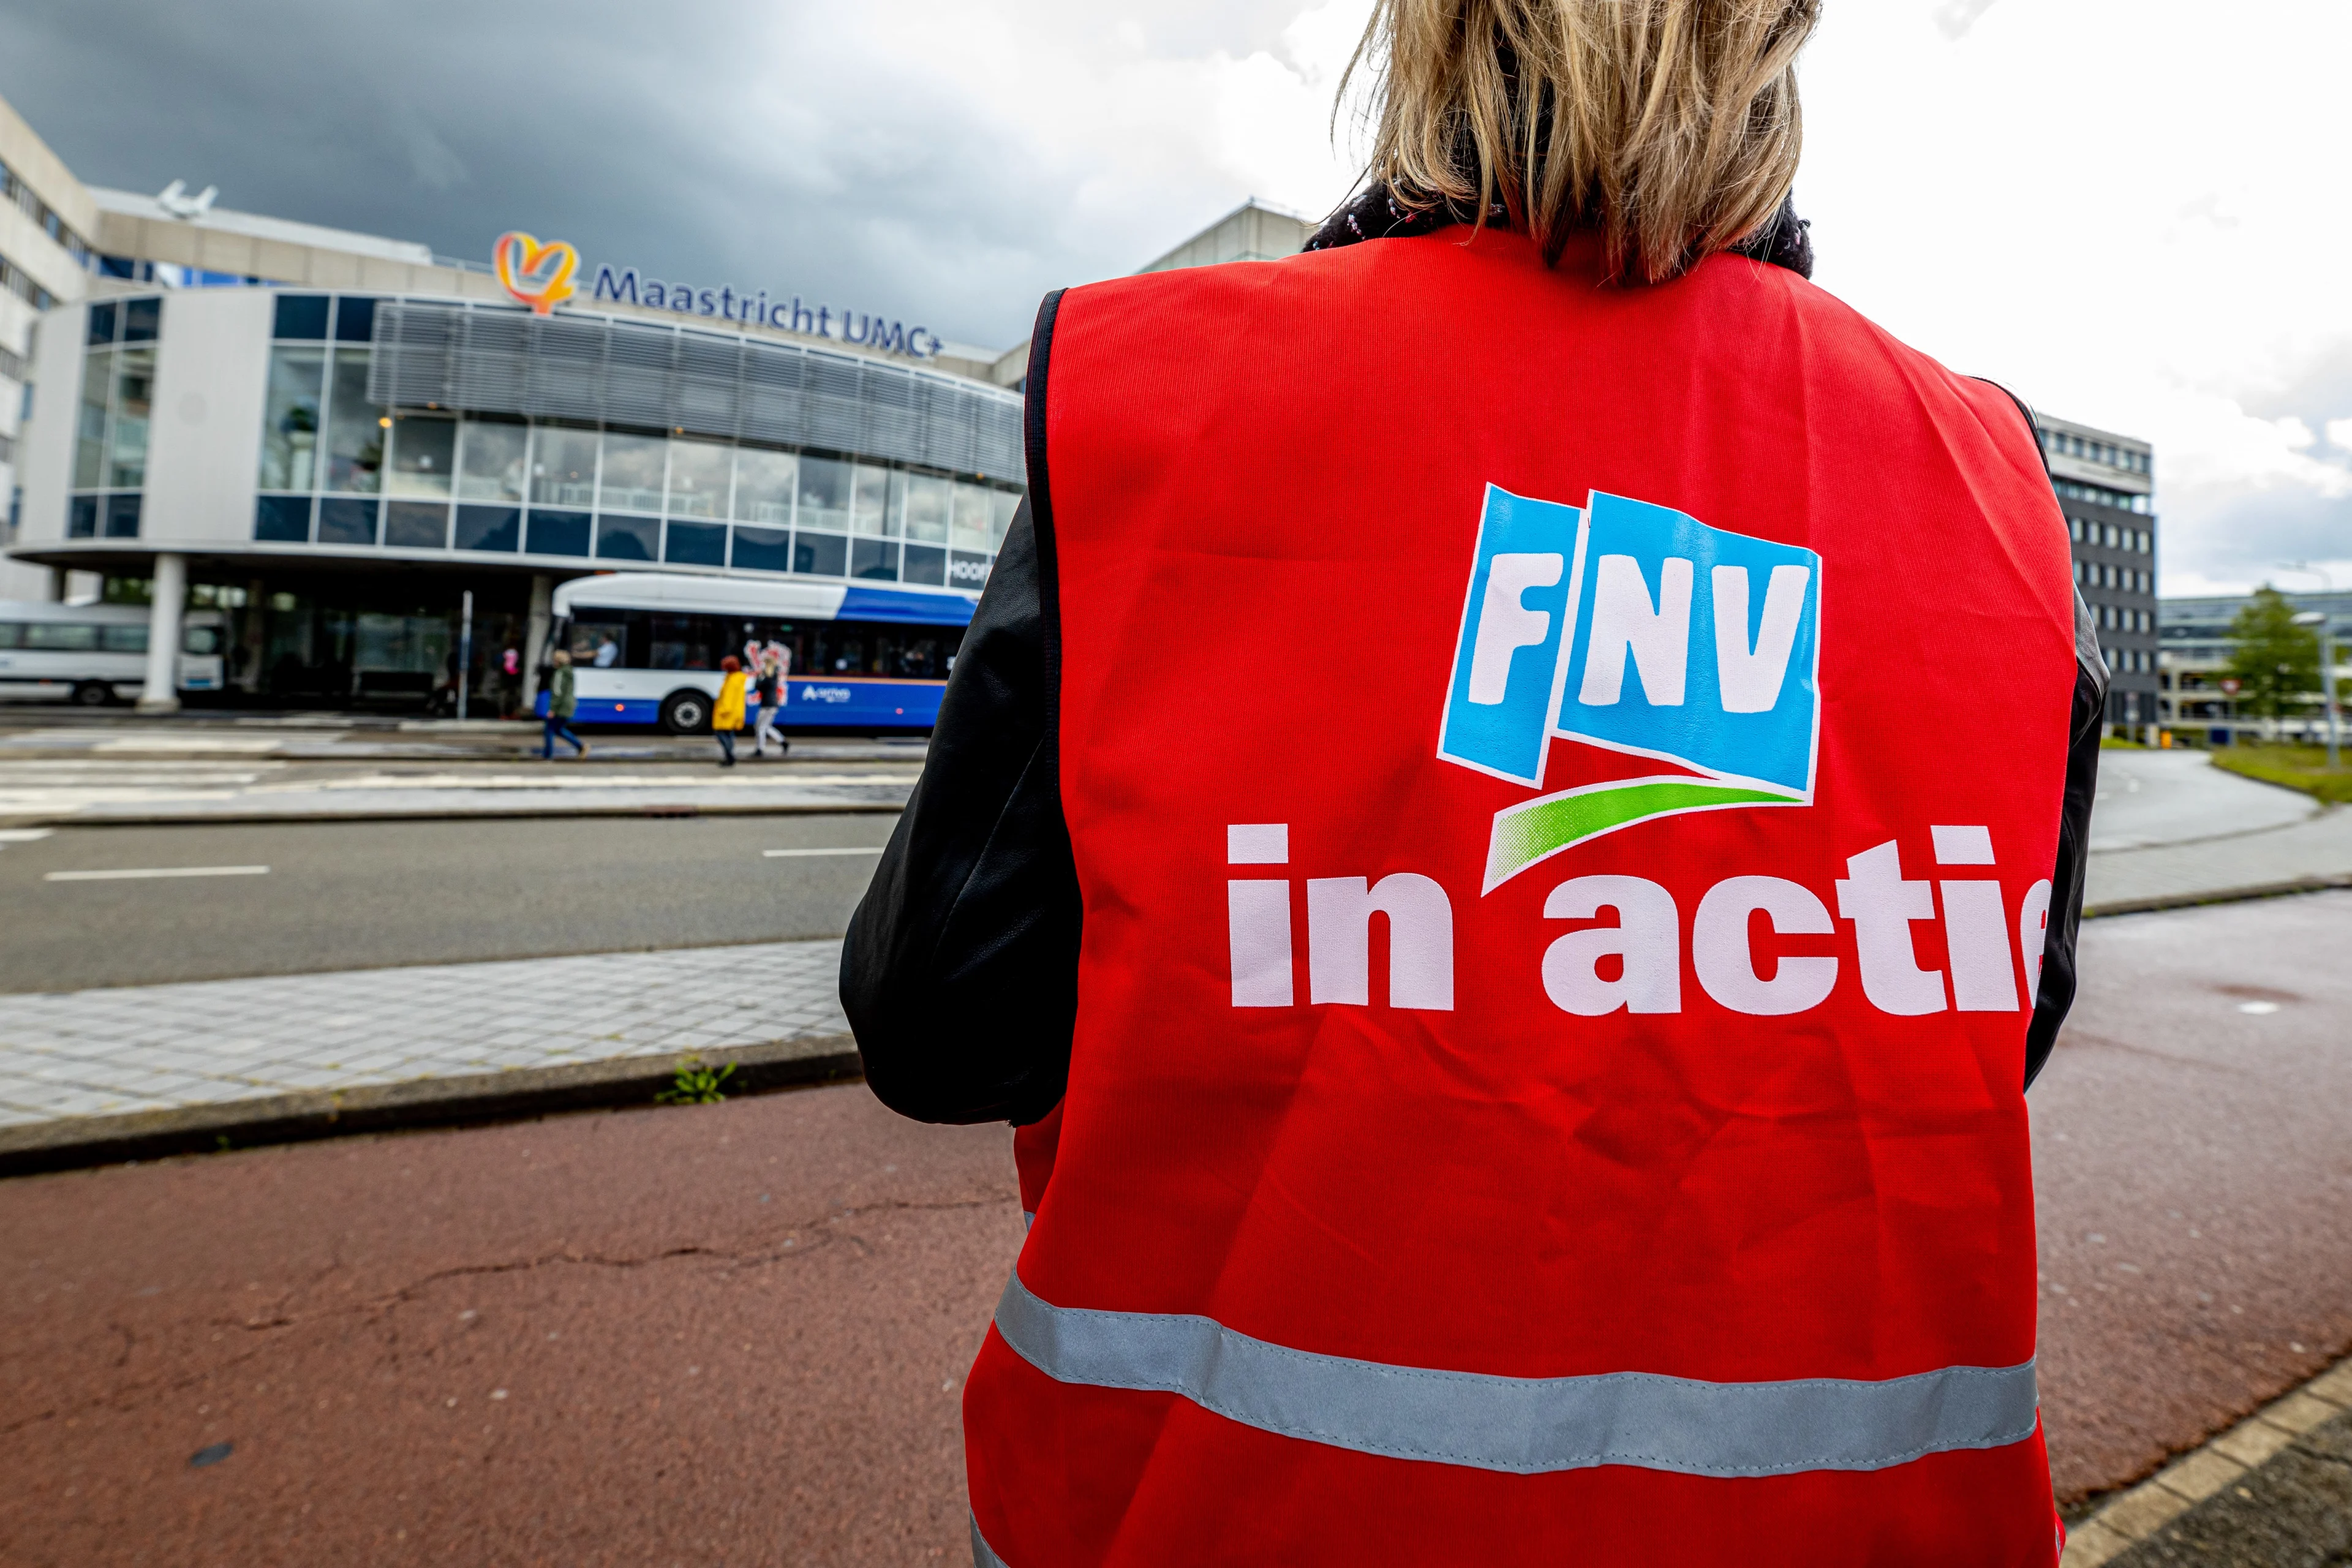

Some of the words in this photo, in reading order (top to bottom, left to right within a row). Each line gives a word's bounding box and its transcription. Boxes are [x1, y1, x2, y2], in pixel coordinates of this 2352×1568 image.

[593, 266, 831, 338] Maastricht
[842, 310, 944, 358] UMC+
[1469, 553, 1810, 713] FNV
[1227, 824, 1453, 1011] in
